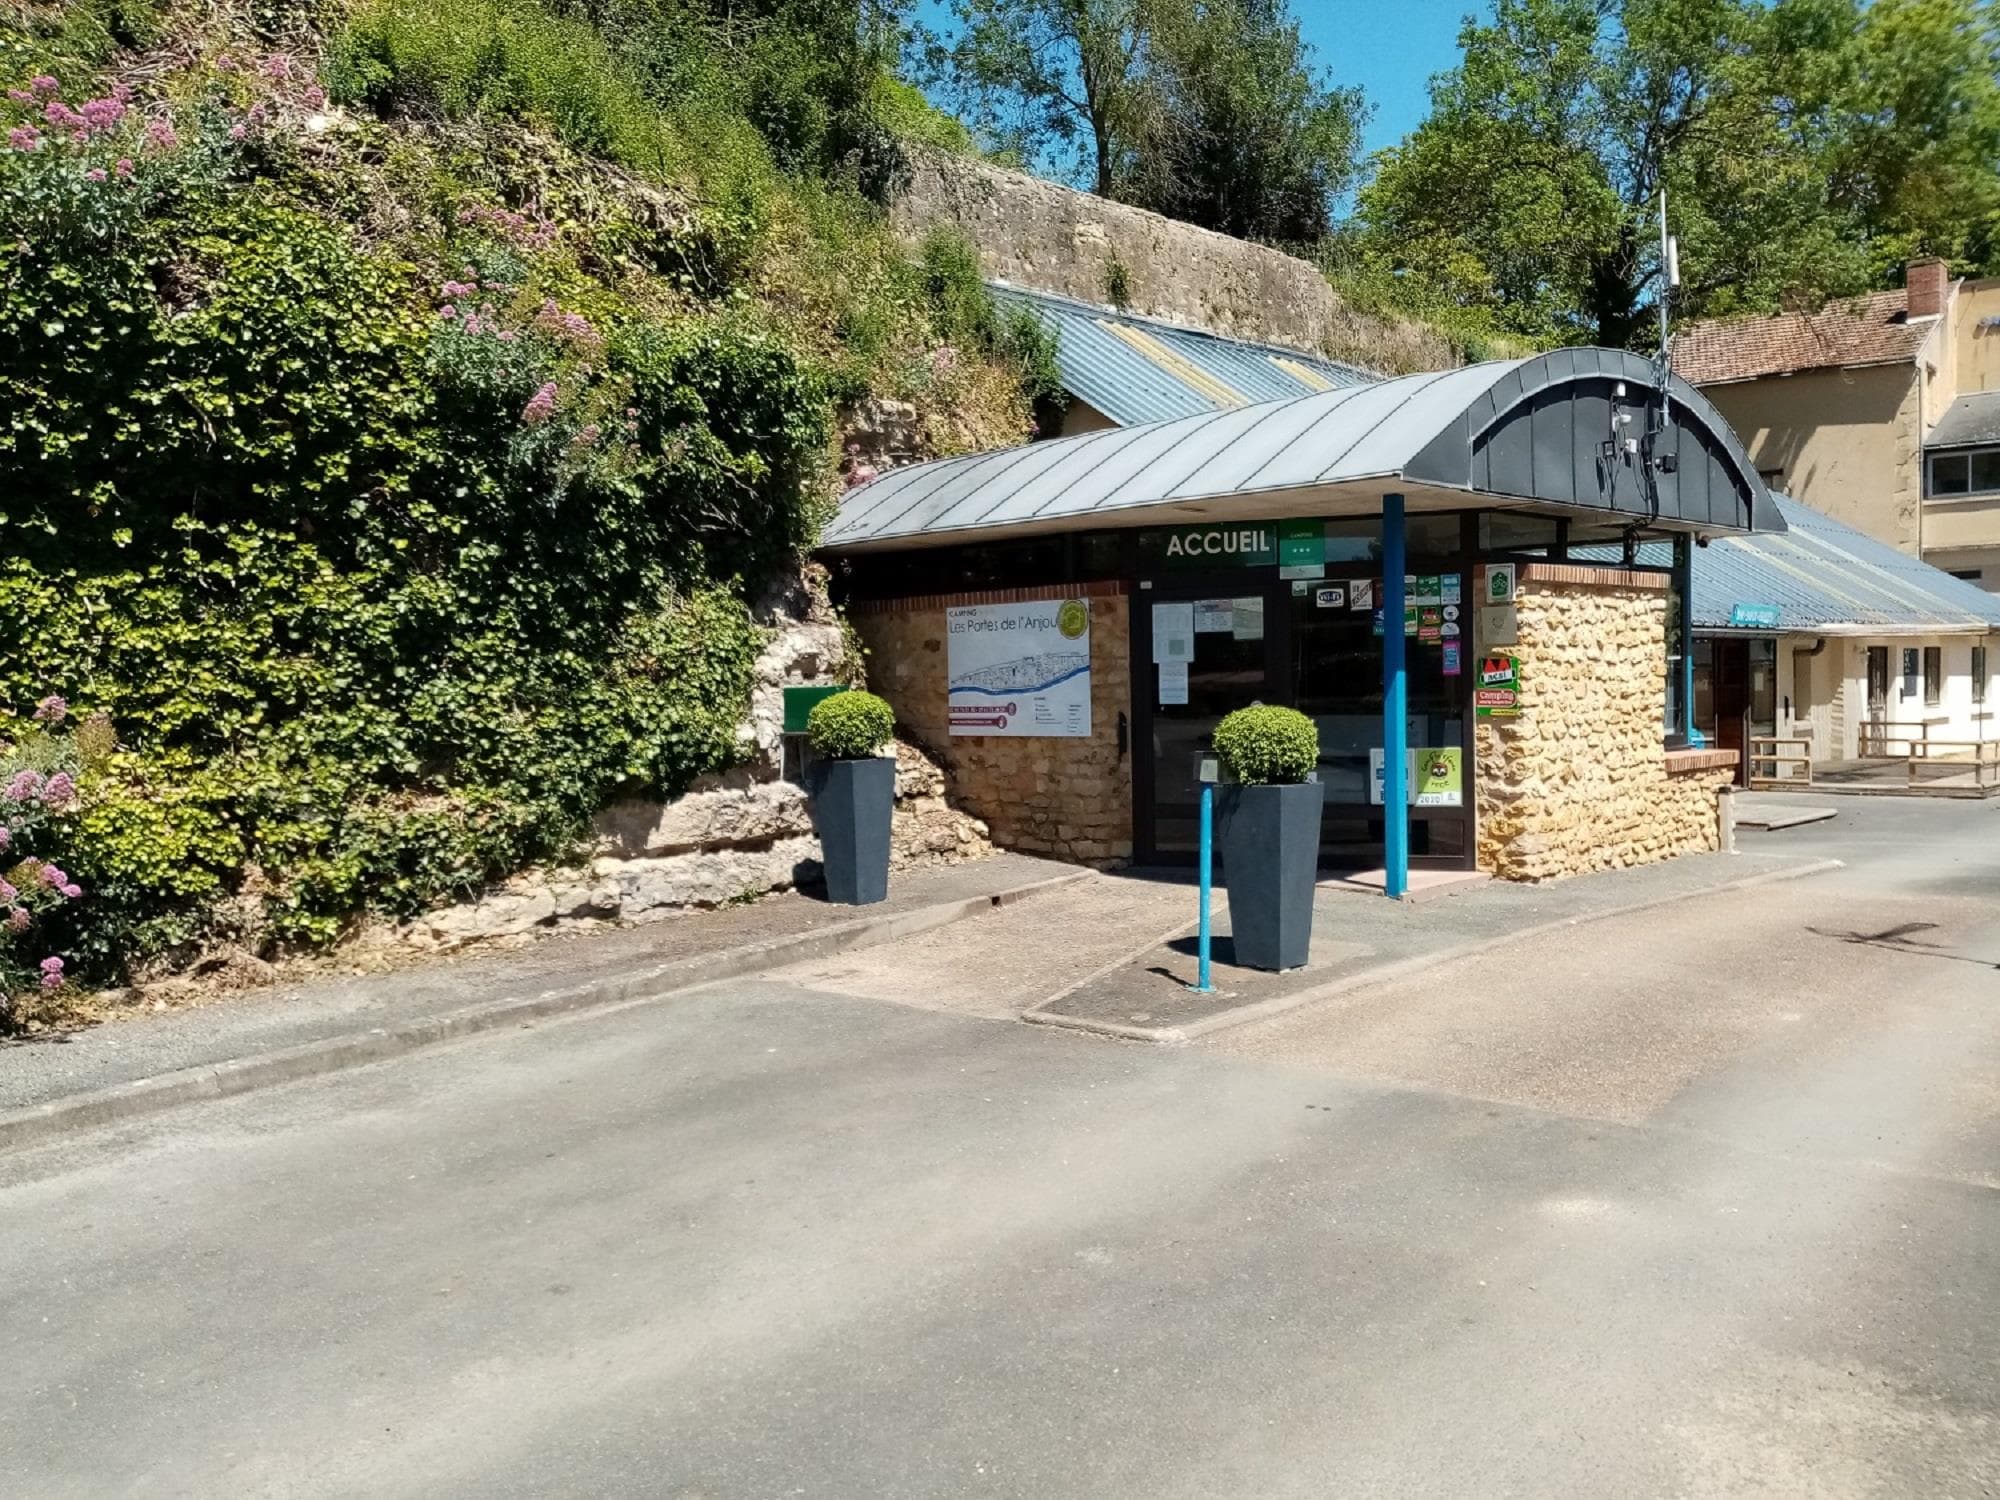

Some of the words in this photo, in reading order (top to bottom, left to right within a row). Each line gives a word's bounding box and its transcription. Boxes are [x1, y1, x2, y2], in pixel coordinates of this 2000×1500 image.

[1166, 530, 1270, 557] ACCUEIL
[948, 608, 977, 618] CAMPING
[950, 622, 966, 634] Les
[967, 617, 999, 633] Portes
[1000, 617, 1016, 631] de
[1018, 615, 1058, 632] l'Anjou
[1479, 690, 1514, 701] Camping
